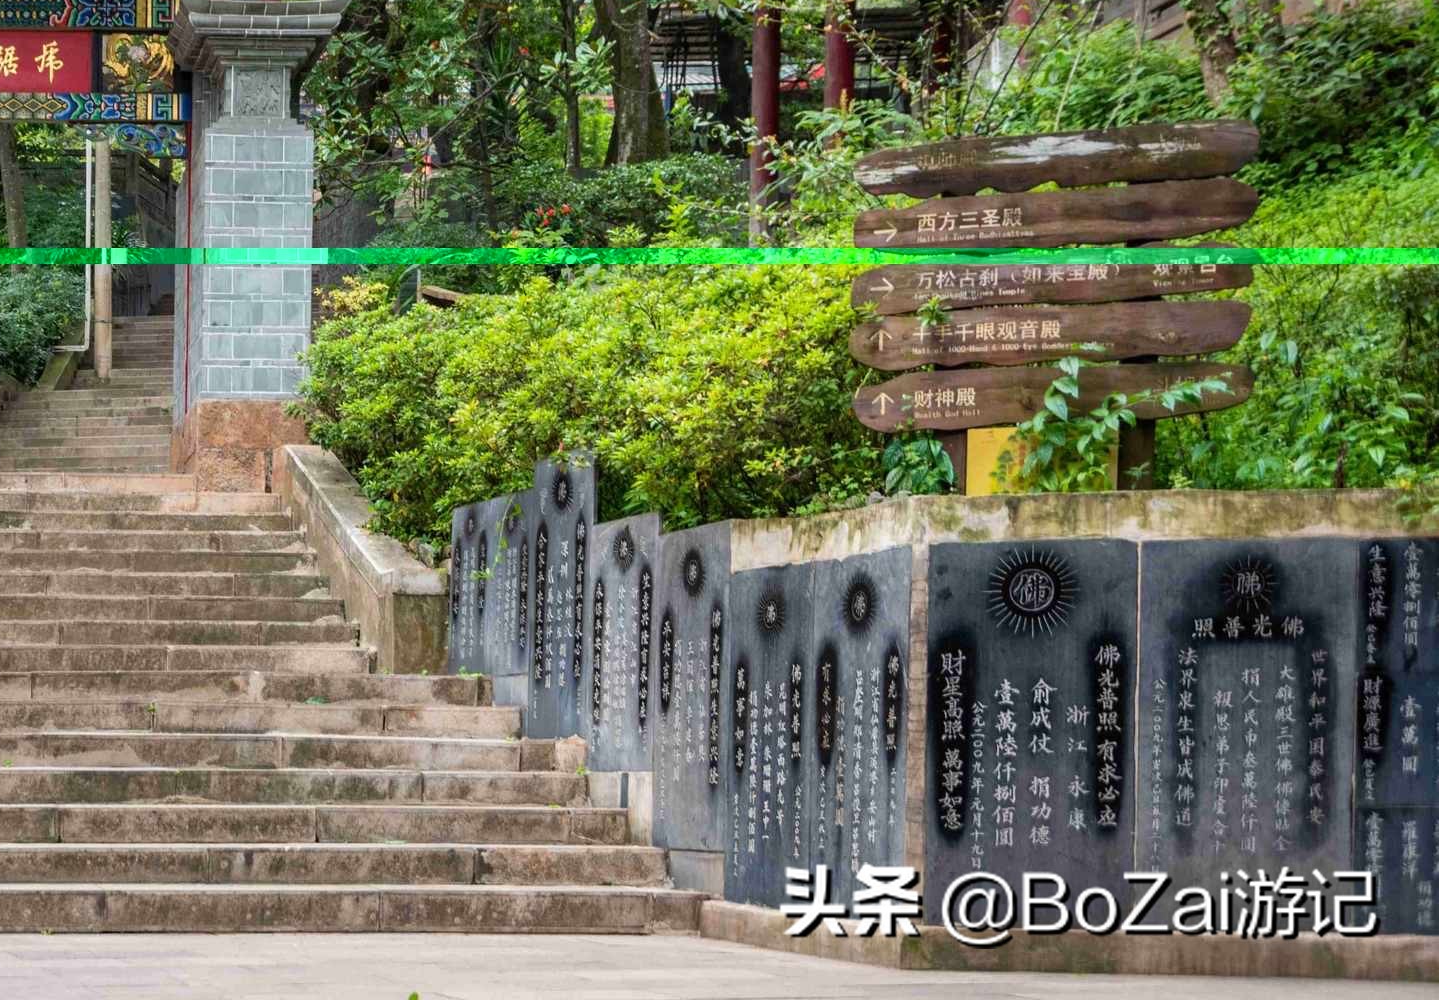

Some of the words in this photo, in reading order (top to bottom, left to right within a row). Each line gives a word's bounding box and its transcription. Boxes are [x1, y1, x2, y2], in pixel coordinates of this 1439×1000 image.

[916, 207, 1022, 233] 西方三圣殿
[913, 319, 1061, 342] 千手千眼观音殿
[914, 388, 976, 408] 财神殿
[791, 663, 802, 759] 佛光普照
[886, 654, 900, 751] 佛光普照
[1029, 775, 1052, 846] 捐功德
